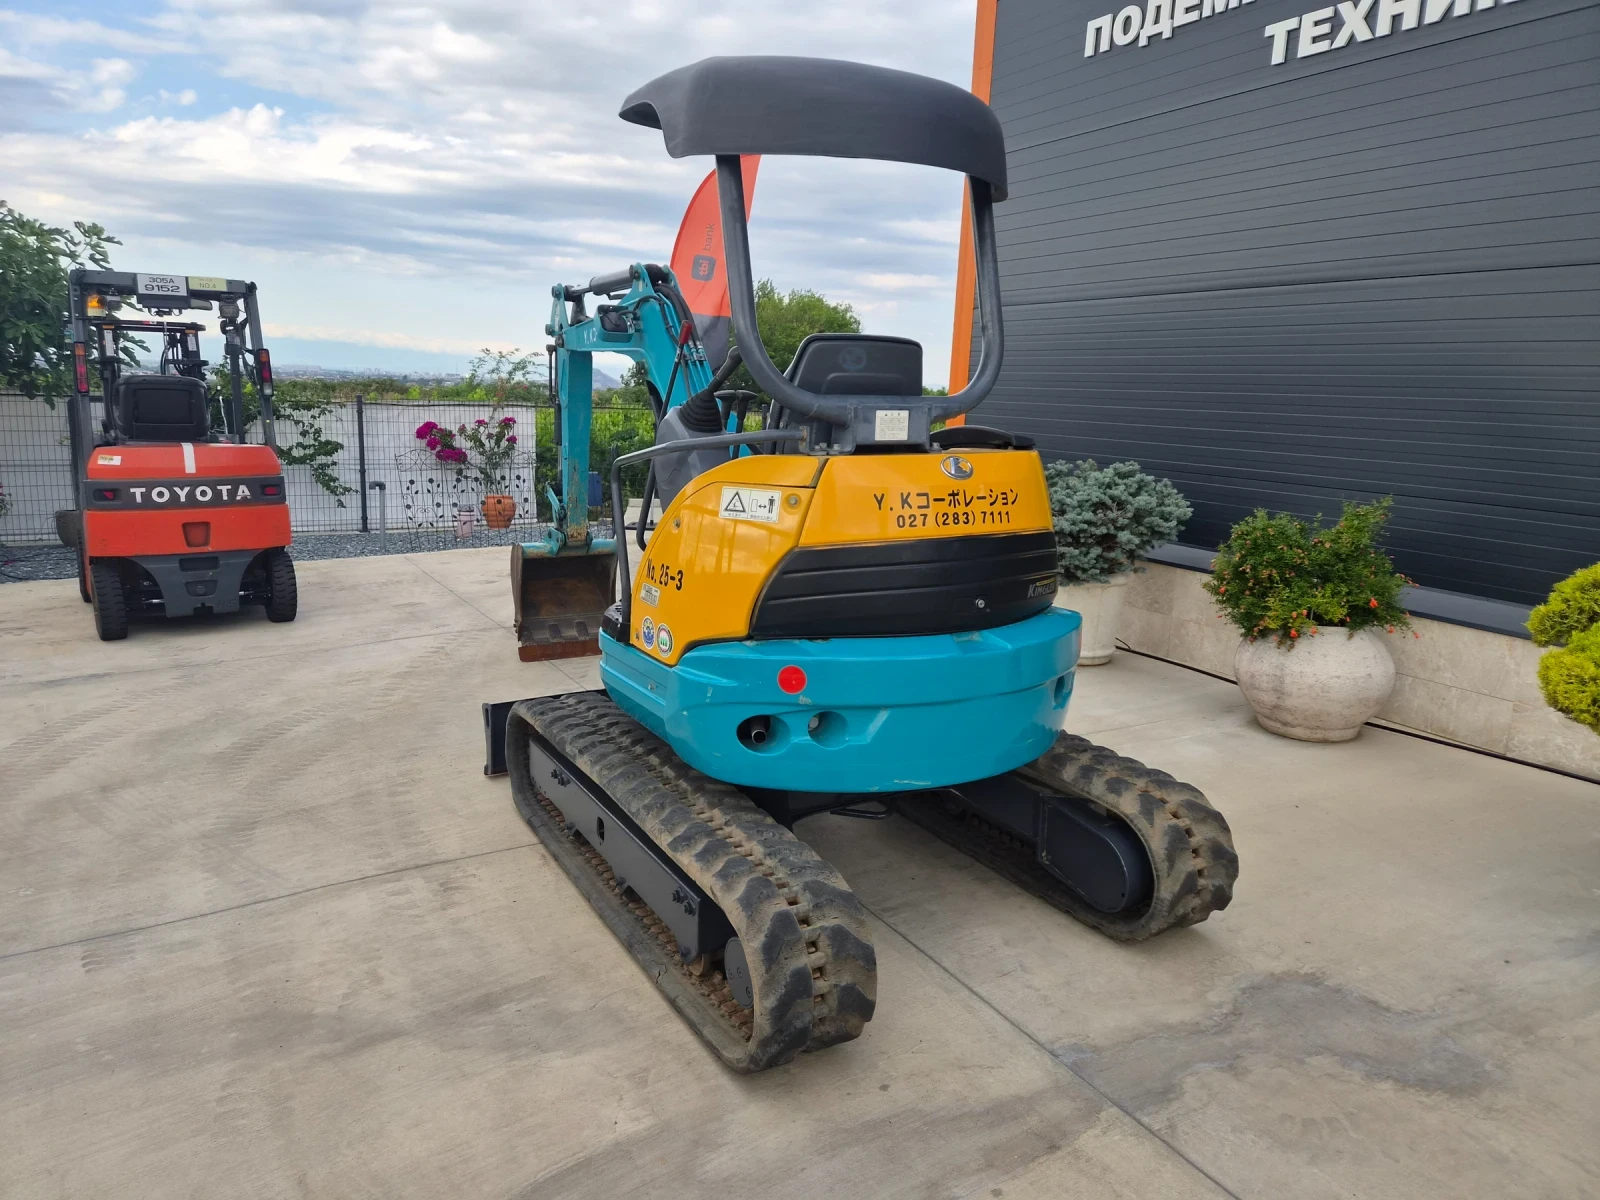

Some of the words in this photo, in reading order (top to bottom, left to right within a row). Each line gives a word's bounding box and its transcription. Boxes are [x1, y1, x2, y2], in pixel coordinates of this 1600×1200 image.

[1084, 0, 1256, 58] ПОДЕ
[702, 223, 715, 252] bank
[699, 260, 710, 276] tbi
[144, 283, 181, 293] 9152
[148, 276, 175, 284] 305A
[130, 484, 252, 503] TOYOTA
